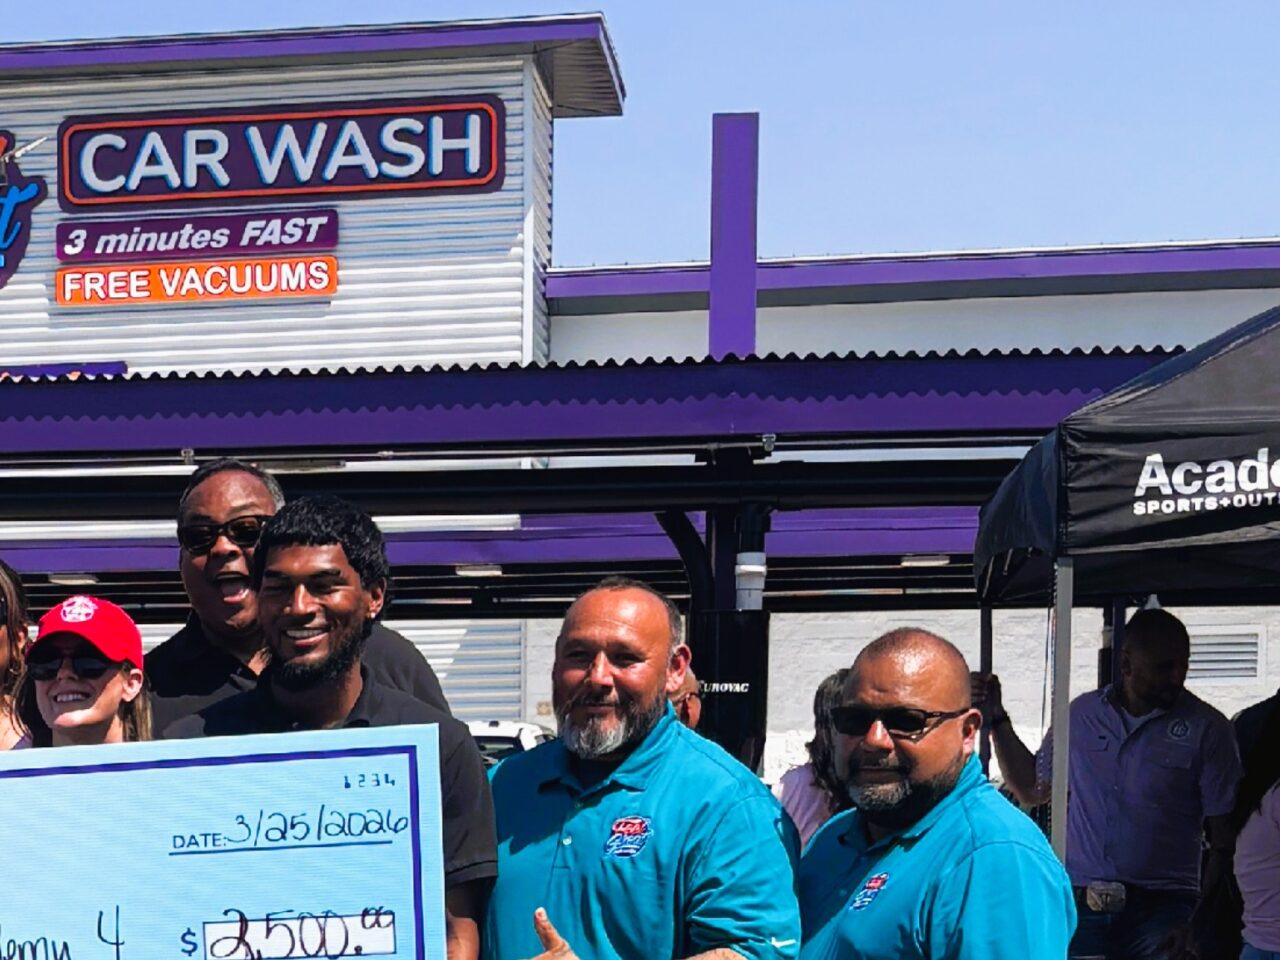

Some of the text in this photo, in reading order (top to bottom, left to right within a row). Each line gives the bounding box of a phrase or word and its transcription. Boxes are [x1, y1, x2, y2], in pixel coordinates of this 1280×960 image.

[79, 113, 482, 193] CAR WASH
[63, 215, 328, 255] 3 minutes FAST
[63, 260, 331, 302] FREE VACUUMS
[1132, 491, 1280, 516] SPORTS+OUT
[344, 773, 396, 789] 1234
[172, 832, 227, 849] DATE:
[227, 804, 409, 847] 3/25/2026
[180, 927, 199, 957] $
